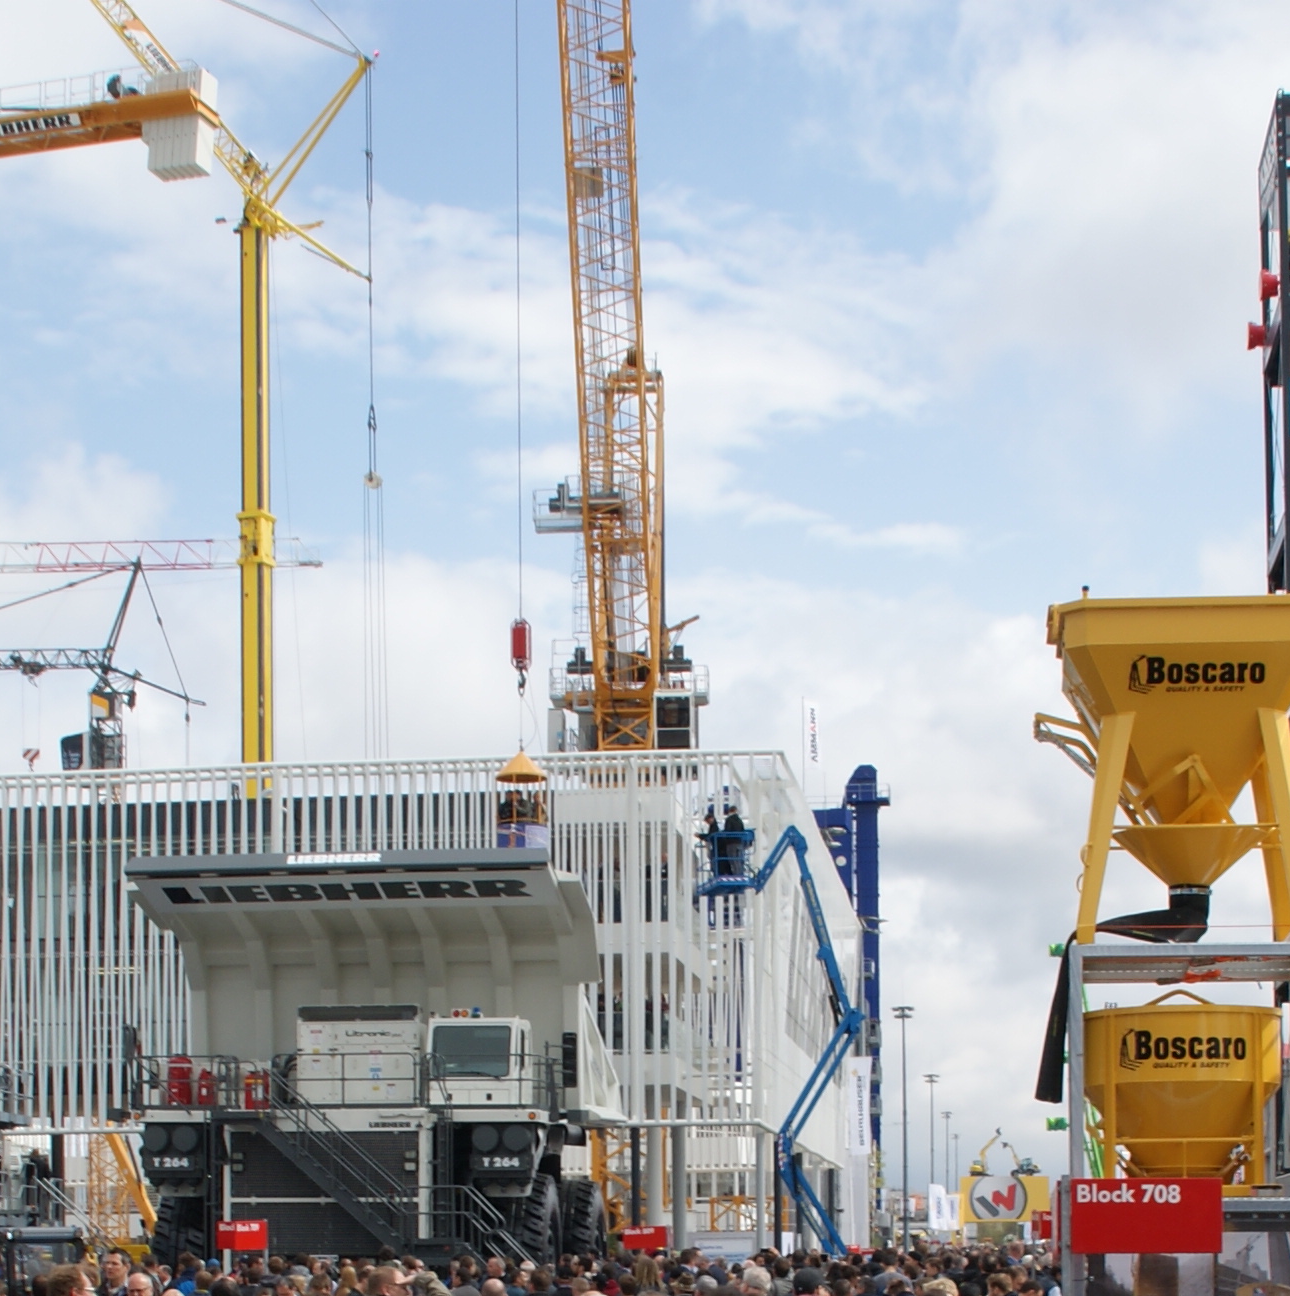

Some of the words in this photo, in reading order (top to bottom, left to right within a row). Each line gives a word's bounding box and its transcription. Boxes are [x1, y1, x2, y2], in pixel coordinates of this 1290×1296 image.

[1146, 656, 1265, 684] Boscaro
[286, 852, 382, 865] LIEBHERR
[161, 880, 532, 904] LIEBHERR
[1135, 1030, 1246, 1060] Boscaro
[152, 1157, 163, 1168] T
[168, 1156, 190, 1168] 264
[483, 1157, 492, 1168] T
[498, 1157, 520, 1168] 264
[1077, 1183, 1136, 1203] Block
[1141, 1184, 1182, 1203] 708
